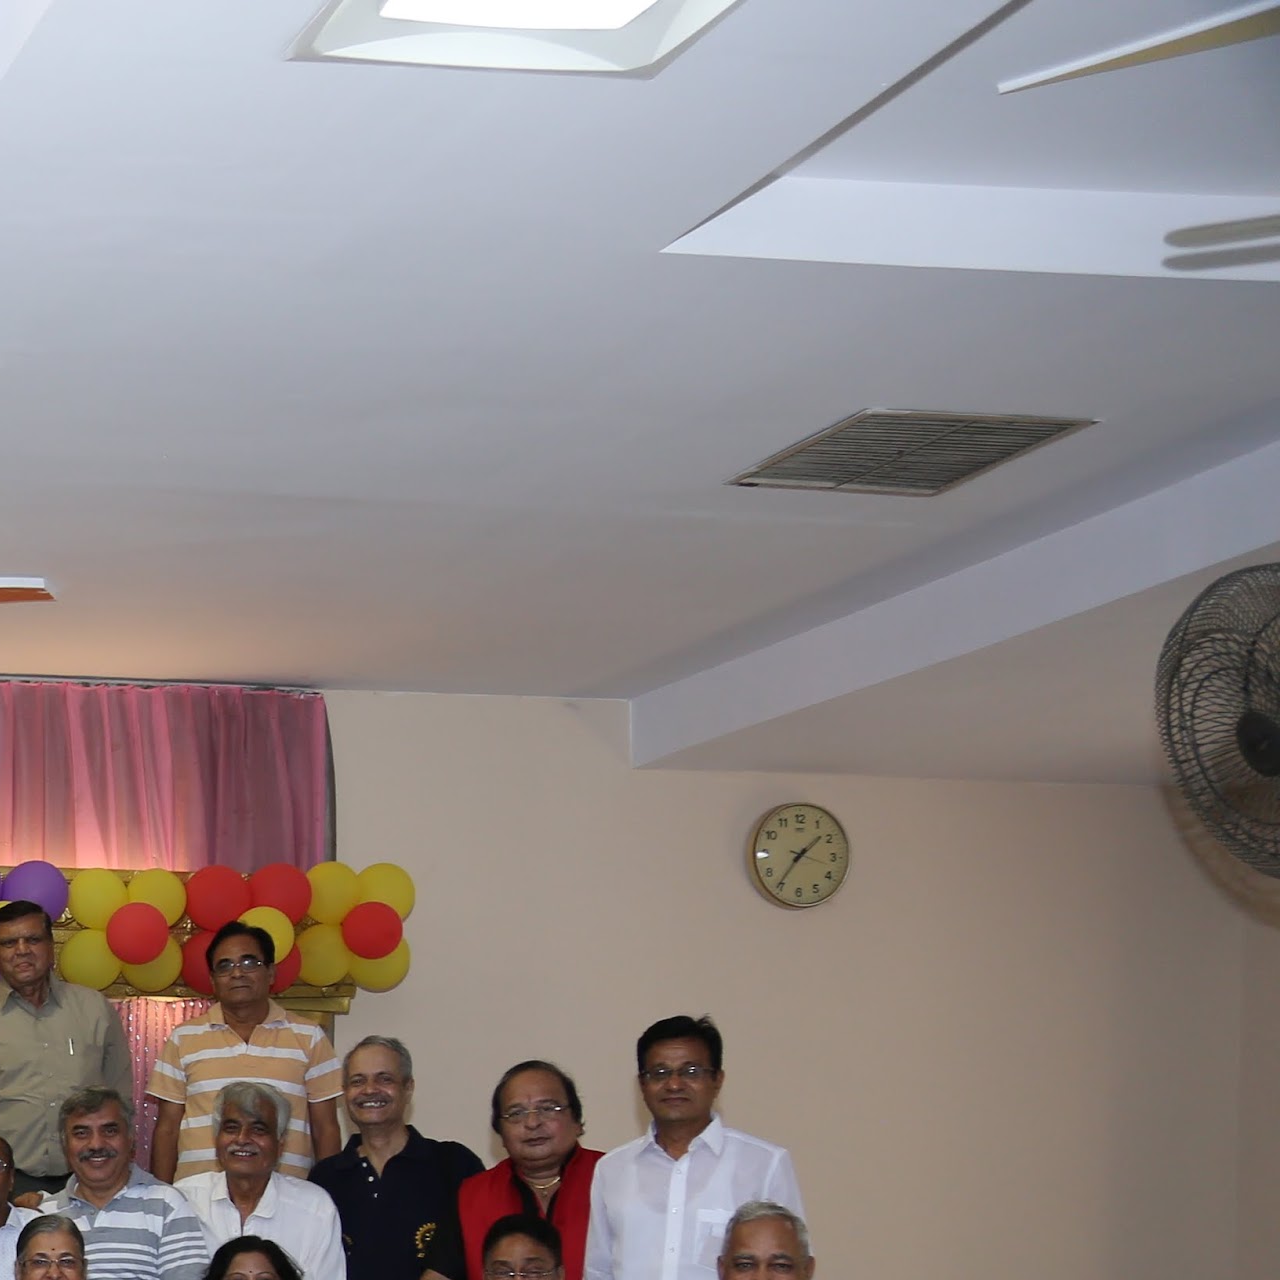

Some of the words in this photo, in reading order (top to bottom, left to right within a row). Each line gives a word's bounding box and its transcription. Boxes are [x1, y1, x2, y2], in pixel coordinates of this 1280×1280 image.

[778, 818, 788, 828] 11
[794, 814, 806, 824] 12
[815, 820, 820, 829] 1
[765, 830, 777, 840] 10
[825, 834, 833, 843] 2
[830, 853, 837, 862] 3
[766, 867, 773, 877] 8
[824, 871, 832, 880] 4
[795, 887, 802, 897] 6
[812, 884, 819, 893] 5
